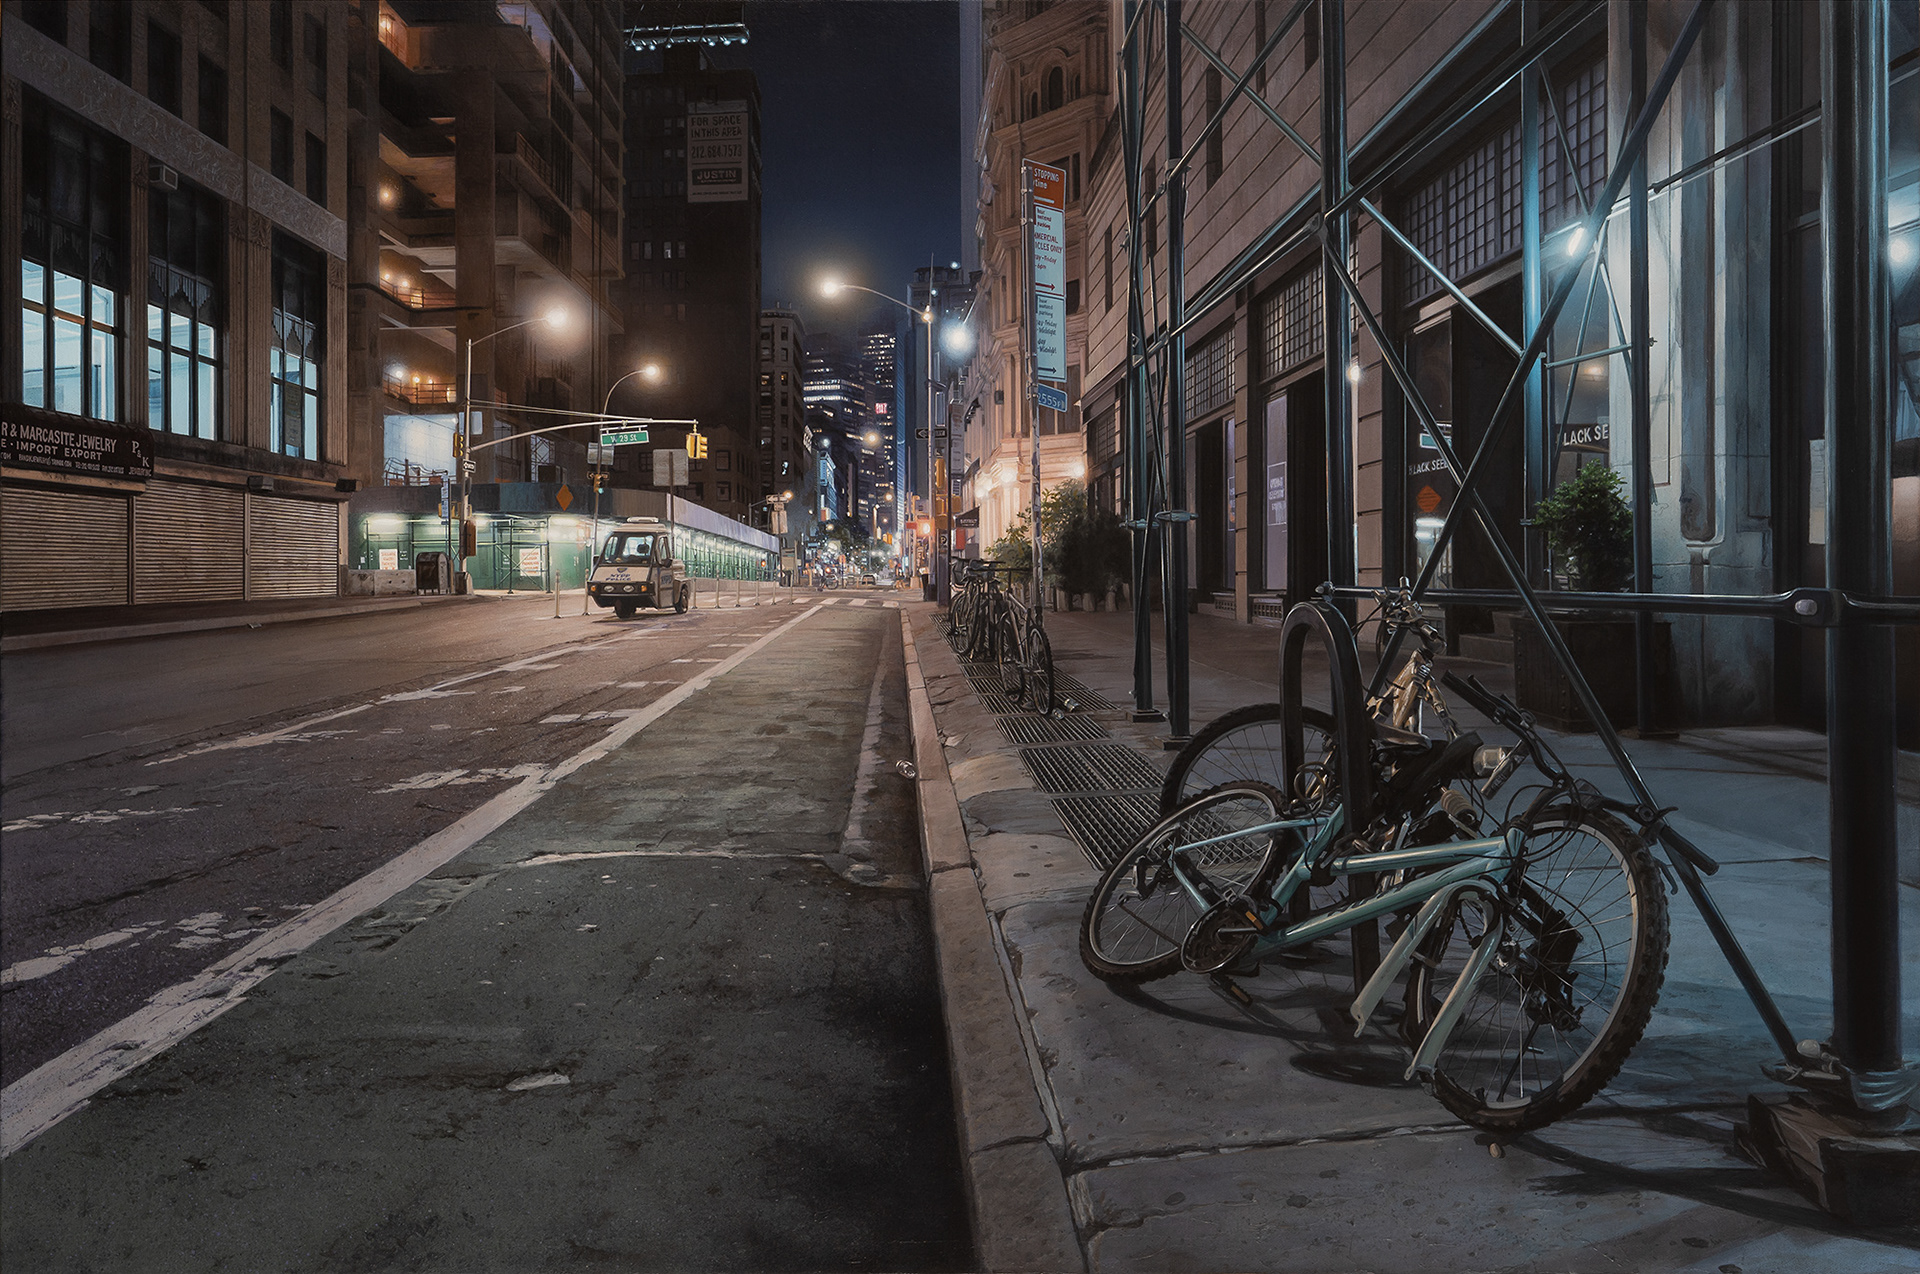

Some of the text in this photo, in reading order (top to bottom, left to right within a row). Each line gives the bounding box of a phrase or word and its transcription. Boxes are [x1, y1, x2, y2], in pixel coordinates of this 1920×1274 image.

[692, 116, 742, 126] FOR SPACE
[692, 126, 742, 138] IN THIS AREA
[697, 170, 736, 179] JUSTIN
[1034, 168, 1059, 182] STOPPING
[10, 424, 17, 437] &
[20, 424, 75, 447] MARCASITE
[76, 434, 117, 453] JEWELRY
[1558, 427, 1592, 447] LACK
[16, 440, 58, 455] IMPORT
[64, 448, 102, 461] EXPORT
[132, 440, 140, 454] P
[142, 457, 150, 468] K
